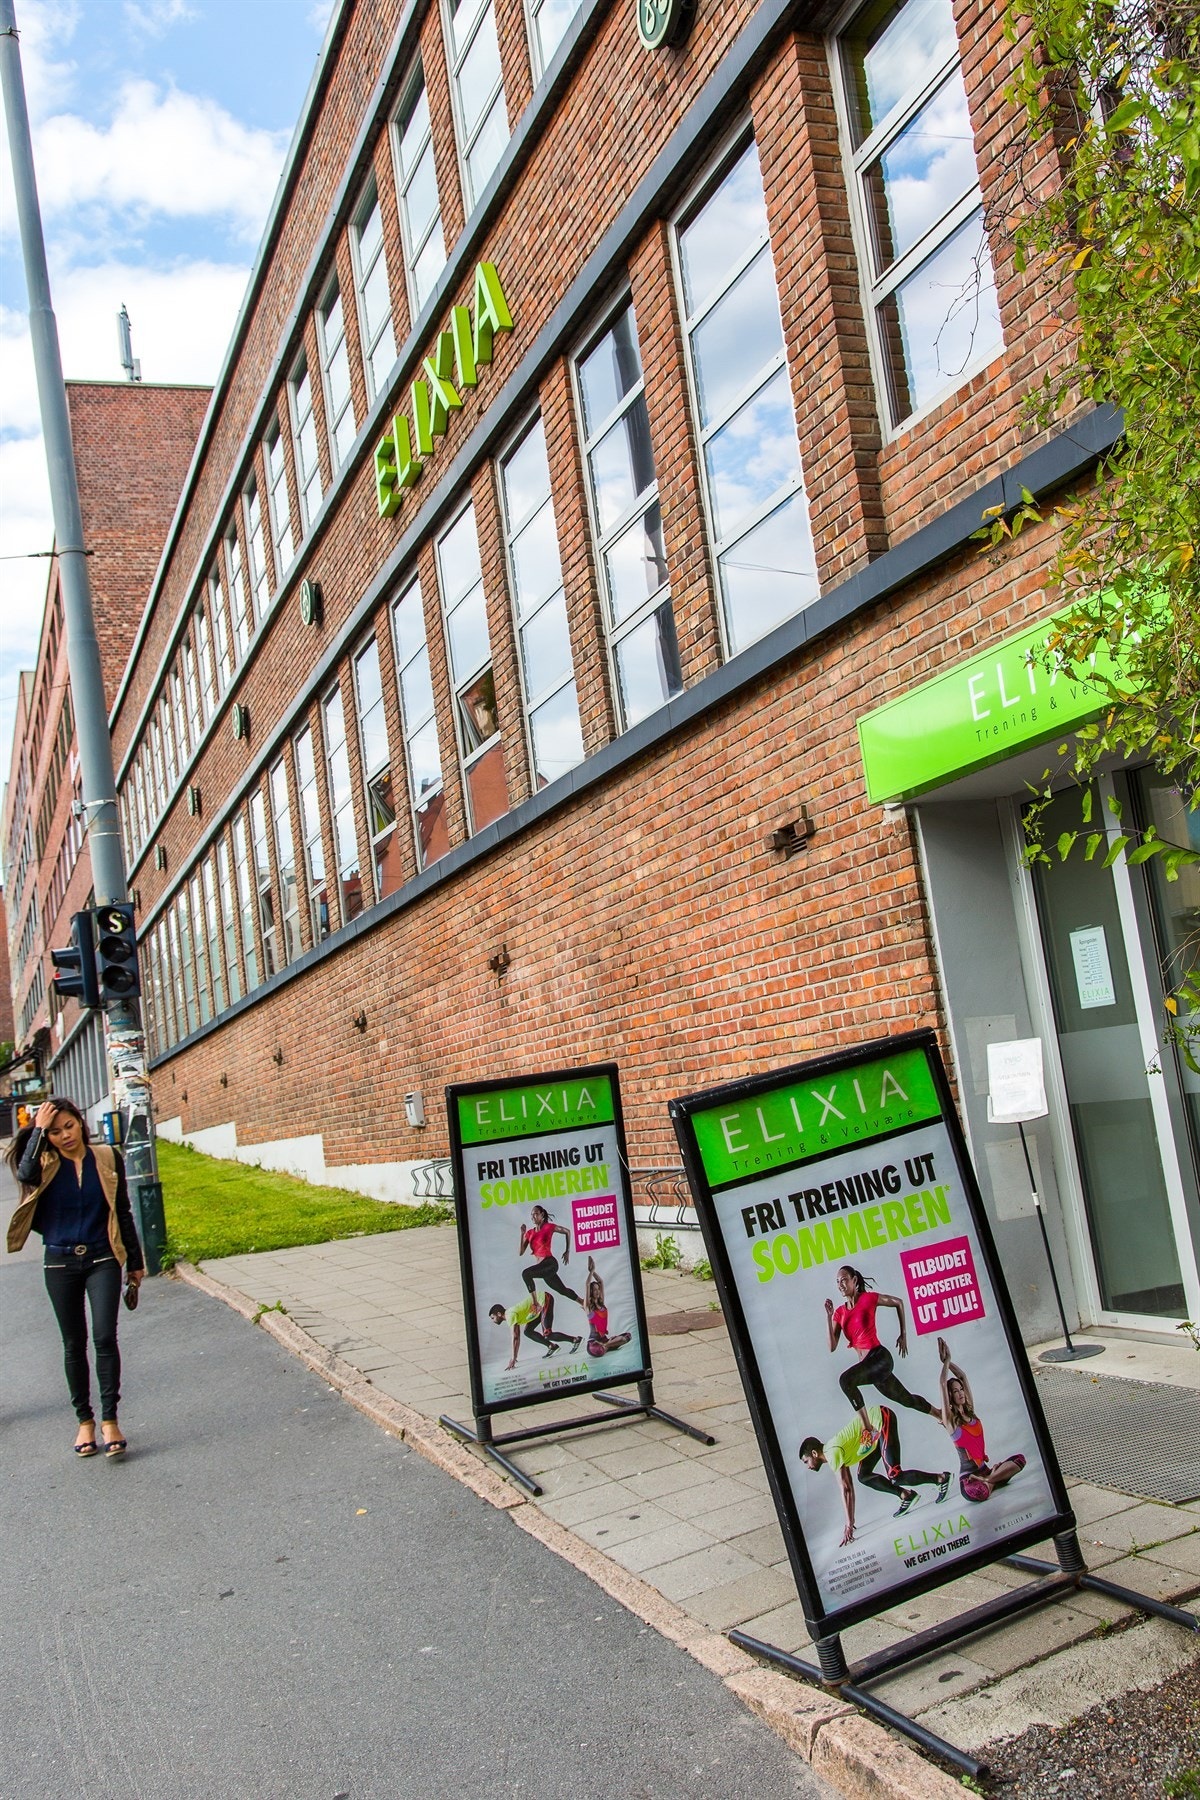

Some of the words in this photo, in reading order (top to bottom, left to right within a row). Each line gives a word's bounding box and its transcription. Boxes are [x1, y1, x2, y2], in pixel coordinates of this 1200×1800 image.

[374, 261, 514, 519] ELIXIA
[975, 706, 1039, 743] Trening
[1049, 696, 1058, 710] &
[107, 911, 123, 935] S
[1082, 987, 1110, 999] ELIXIA
[475, 1087, 596, 1125] ELIXIA
[720, 1069, 909, 1154] ELIXIA
[478, 1124, 527, 1135] Trening
[550, 1113, 598, 1126] Velvære
[732, 1142, 807, 1171] Trening
[820, 1134, 829, 1145] &
[841, 1108, 914, 1138] Velvære
[477, 1159, 505, 1181] FRI
[509, 1147, 581, 1176] TRENING
[584, 1142, 604, 1163] UT
[576, 1203, 614, 1218] TILBUDET
[741, 1199, 787, 1238] FRI
[788, 1164, 901, 1223] TRENING
[904, 1152, 937, 1187] UT
[577, 1218, 615, 1231] FORTSETTER
[578, 1234, 591, 1246] UT
[593, 1228, 617, 1244] JULI!
[908, 1249, 967, 1279] TILBUDET
[913, 1273, 973, 1300] FORTSETTER
[917, 1304, 938, 1324] UT
[942, 1290, 979, 1319] JULI!
[538, 1362, 590, 1380] ELIXIA
[552, 1380, 561, 1388] GET
[561, 1378, 571, 1387] YOU
[571, 1374, 588, 1384] THERE!
[893, 1514, 972, 1557] ELIXIA
[903, 1558, 917, 1569] WE
[917, 1551, 932, 1564] GET
[931, 1546, 947, 1558] YOU
[946, 1534, 971, 1551] THERE!
